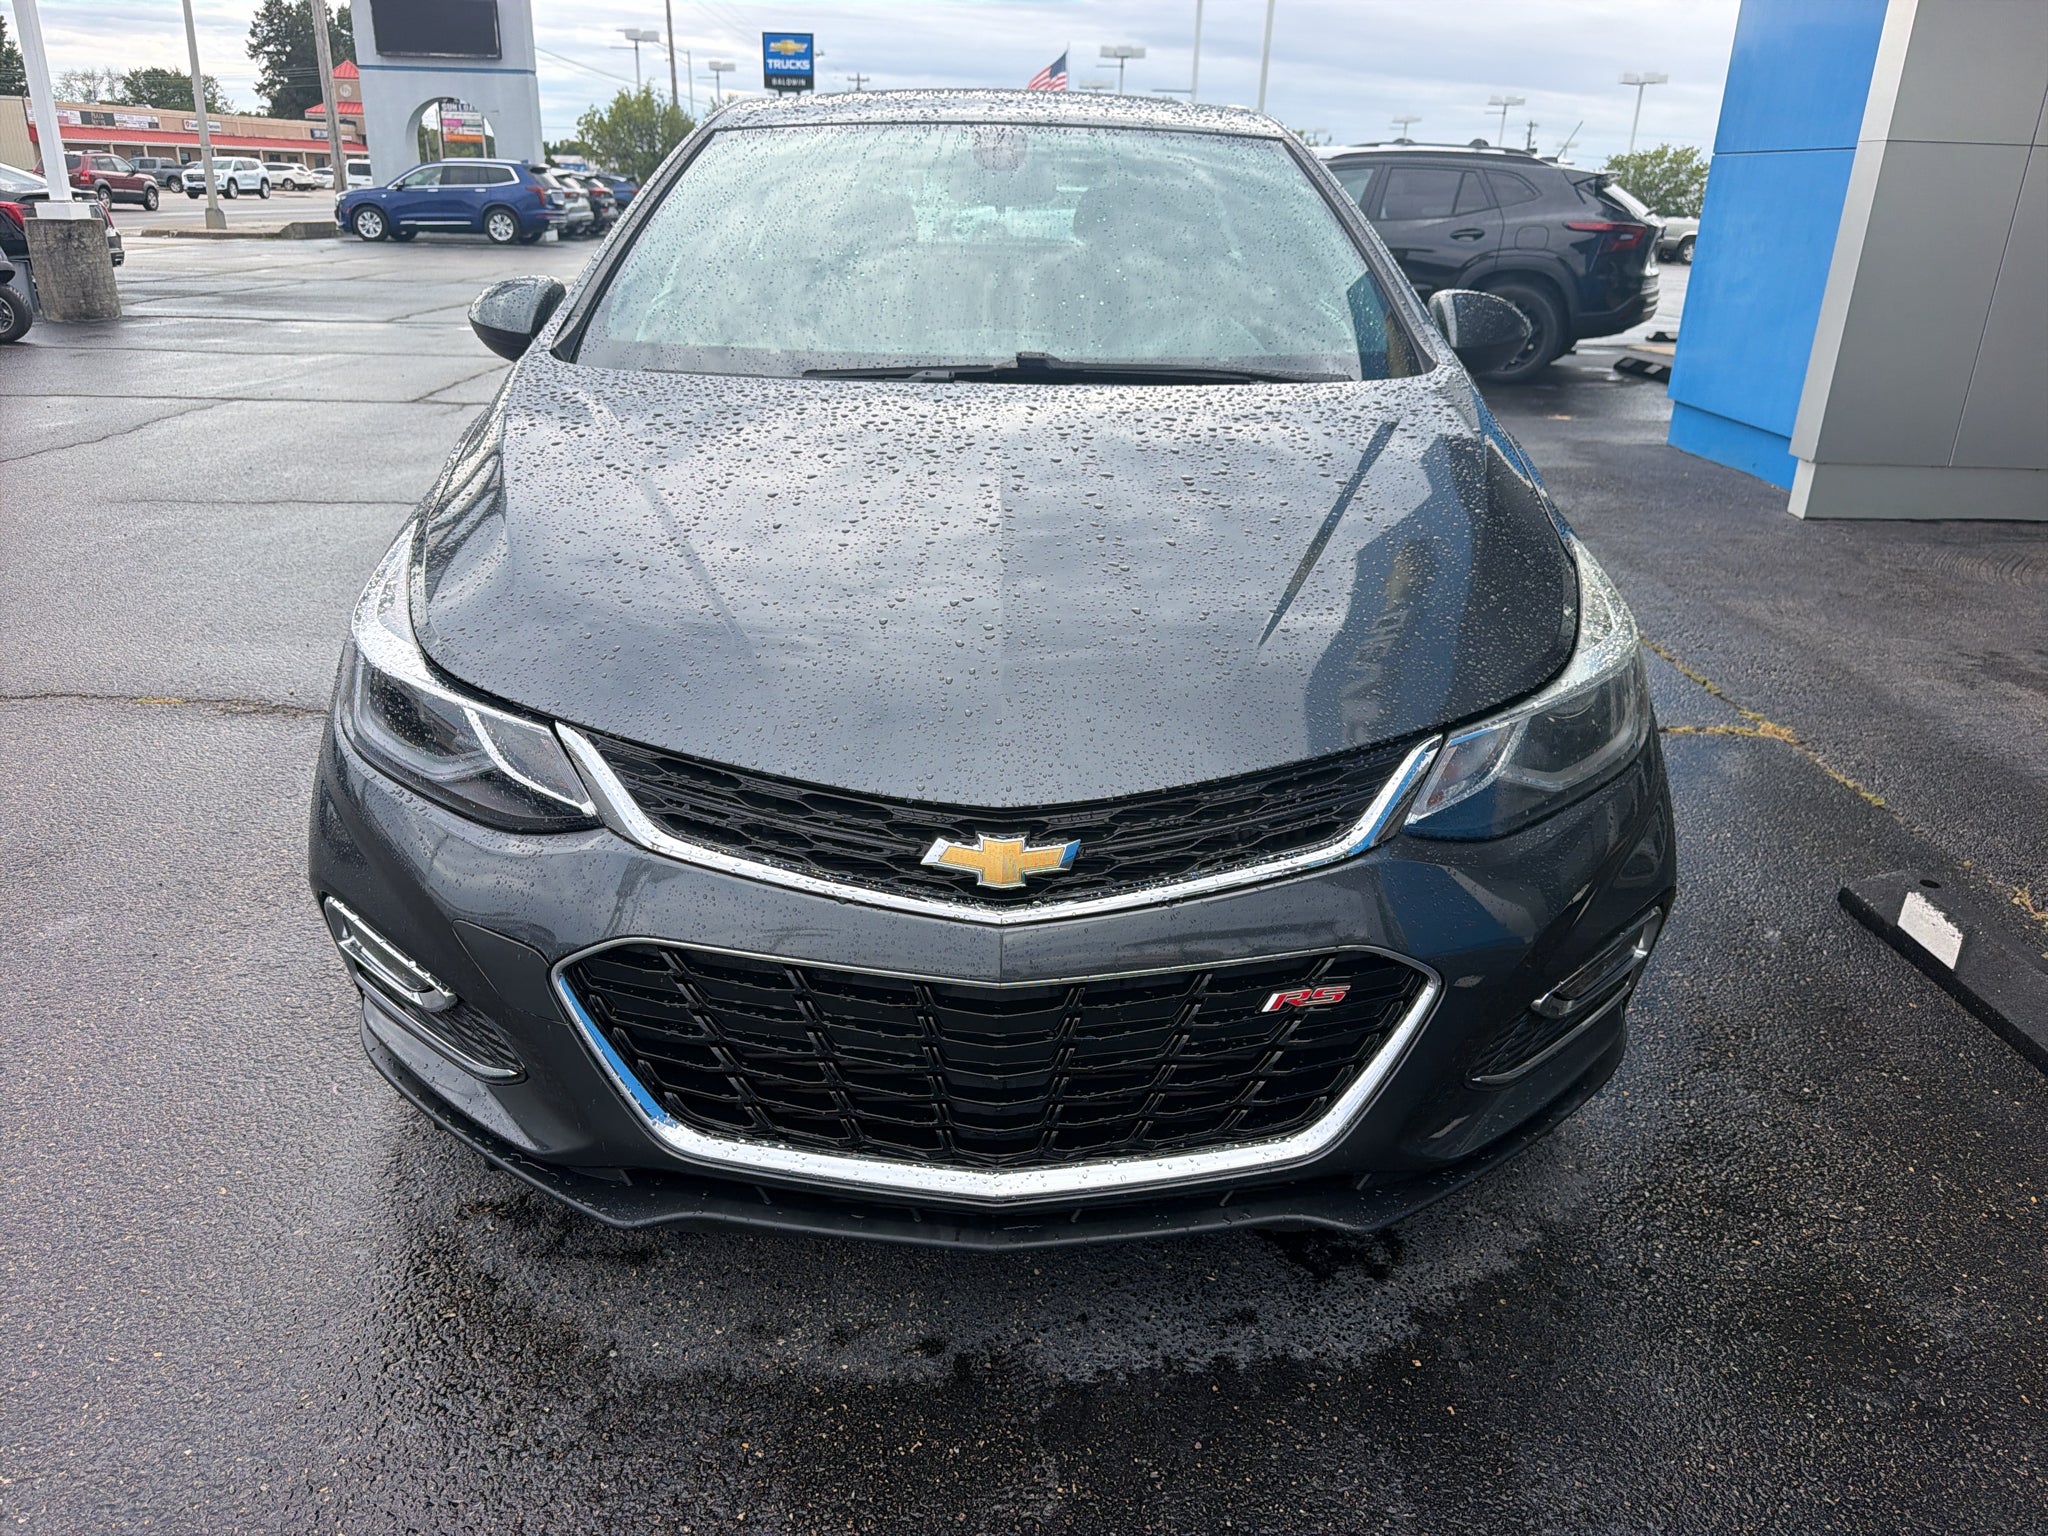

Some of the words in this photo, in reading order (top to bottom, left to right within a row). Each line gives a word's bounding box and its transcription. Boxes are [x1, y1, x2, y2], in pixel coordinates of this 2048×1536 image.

[766, 58, 810, 70] TRUCKS
[771, 77, 806, 86] BALDWIN
[1261, 985, 1351, 1013] RS
